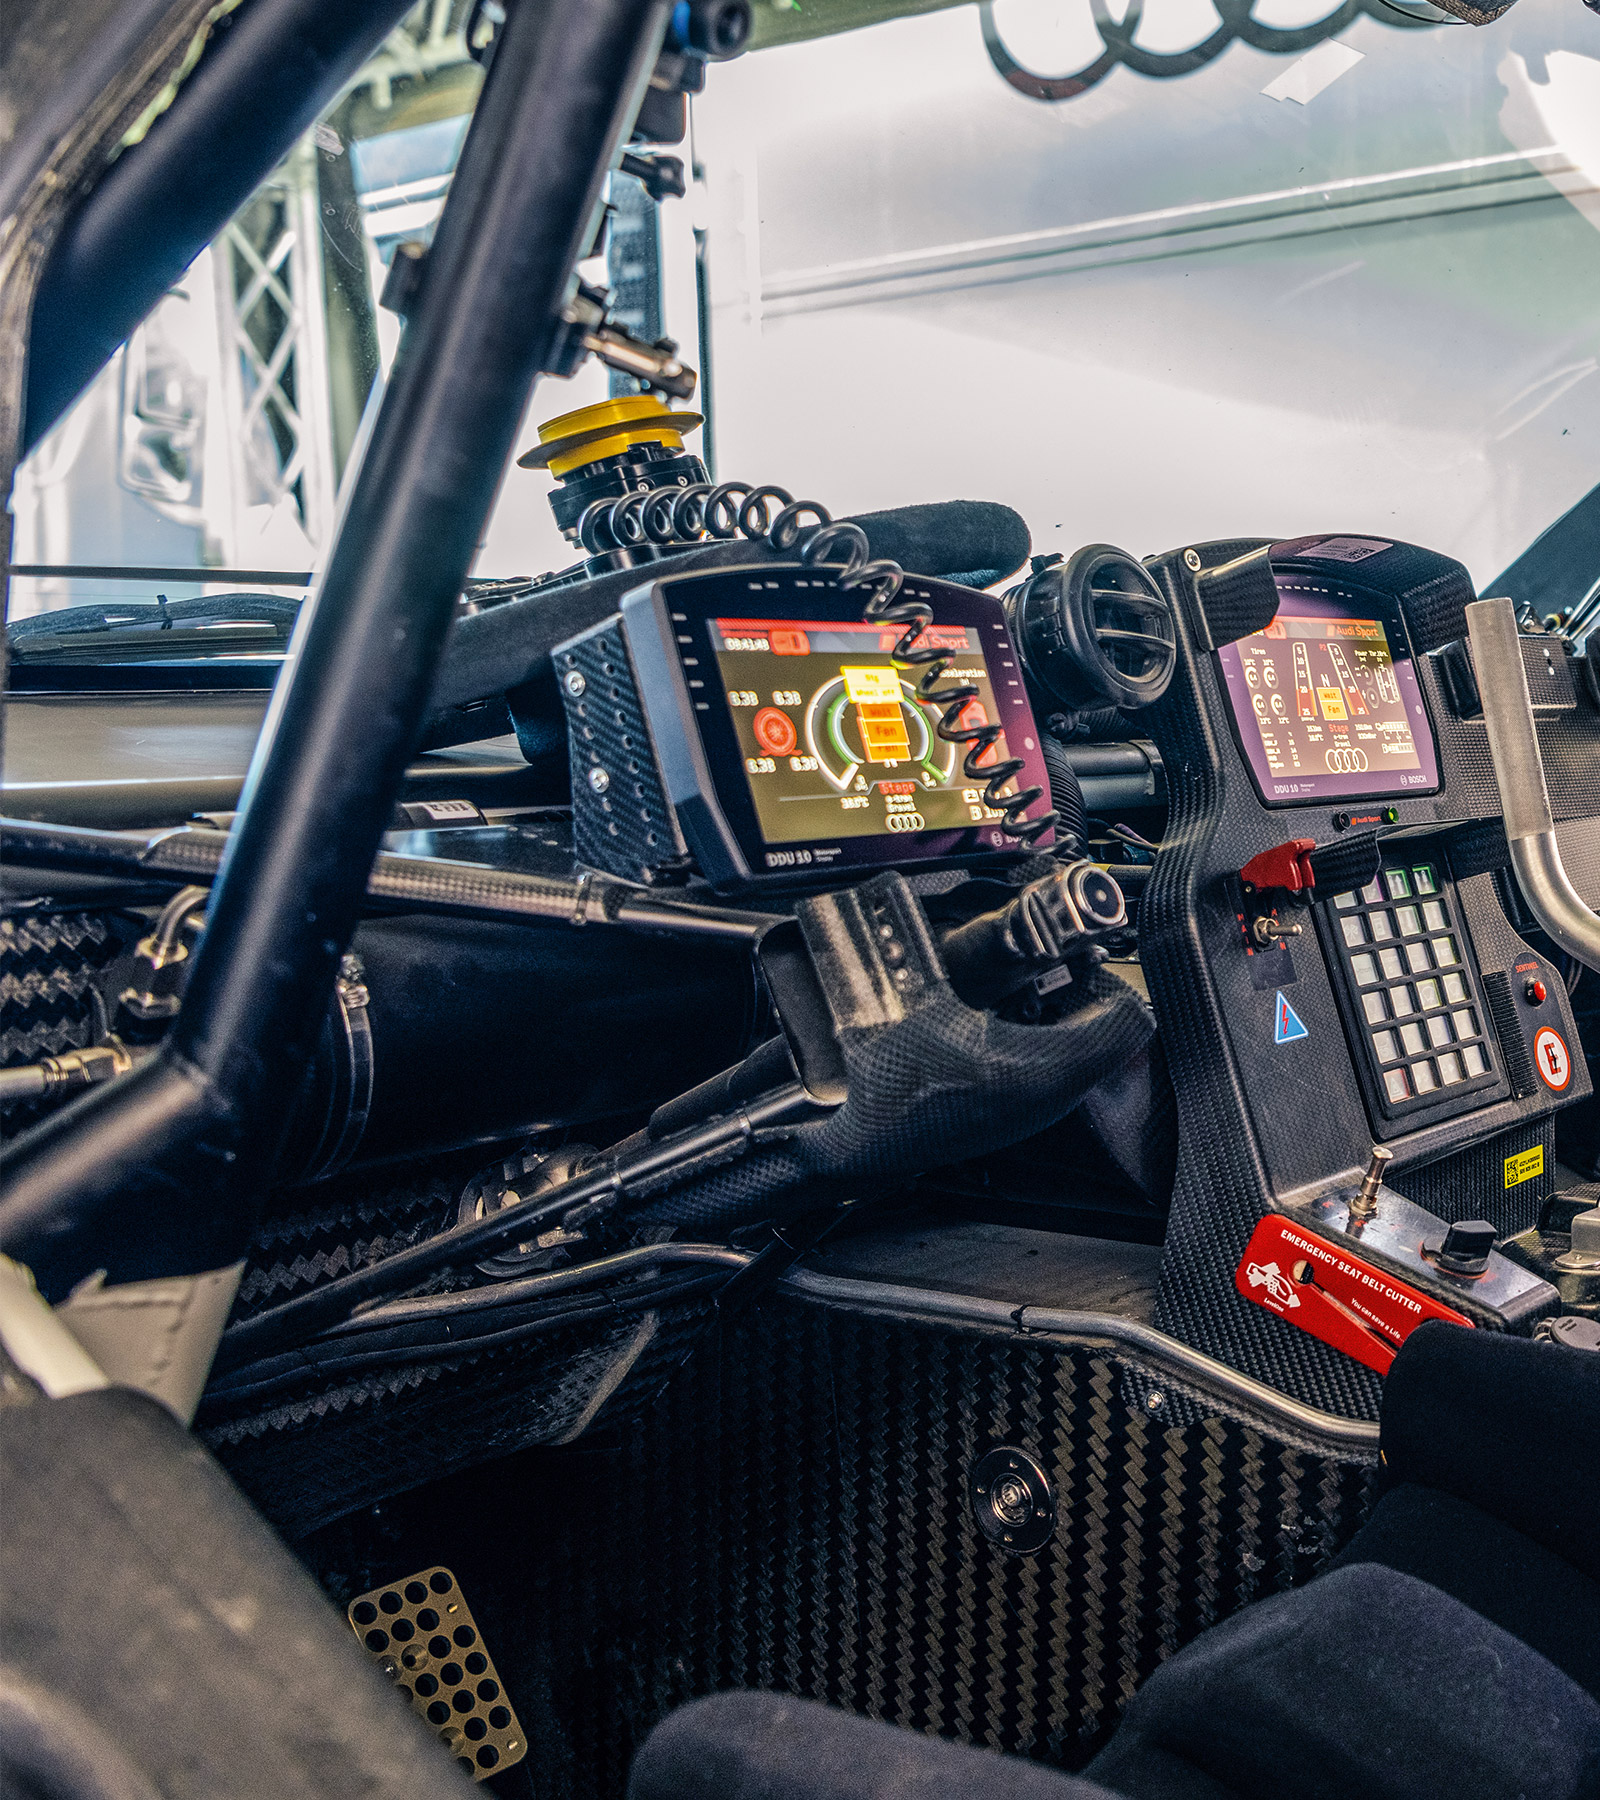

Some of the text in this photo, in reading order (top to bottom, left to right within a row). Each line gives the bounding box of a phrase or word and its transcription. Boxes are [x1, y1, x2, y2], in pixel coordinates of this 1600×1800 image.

[1336, 626, 1379, 638] Audi Sport
[929, 634, 970, 649] Sport
[1297, 657, 1304, 665] 10
[1337, 658, 1344, 666] 10
[1298, 670, 1306, 678] 15
[1321, 674, 1330, 687] N
[1300, 686, 1308, 694] 20
[1327, 706, 1340, 714] Fan
[1357, 707, 1365, 715] 25
[875, 725, 897, 737] Fan
[1328, 723, 1349, 734] Stage
[1408, 775, 1427, 784] BOSCH
[879, 781, 916, 795] Stage
[1274, 783, 1299, 794] DDU 10
[765, 849, 812, 867] DDU 10
[1515, 962, 1539, 973] SENTINEL
[1543, 1042, 1562, 1076] E
[1280, 1229, 1422, 1314] EMERGENCY SEAT BELT CUTTER
[1351, 1297, 1362, 1310] You
[1361, 1307, 1372, 1317] can
[1371, 1314, 1385, 1327] save
